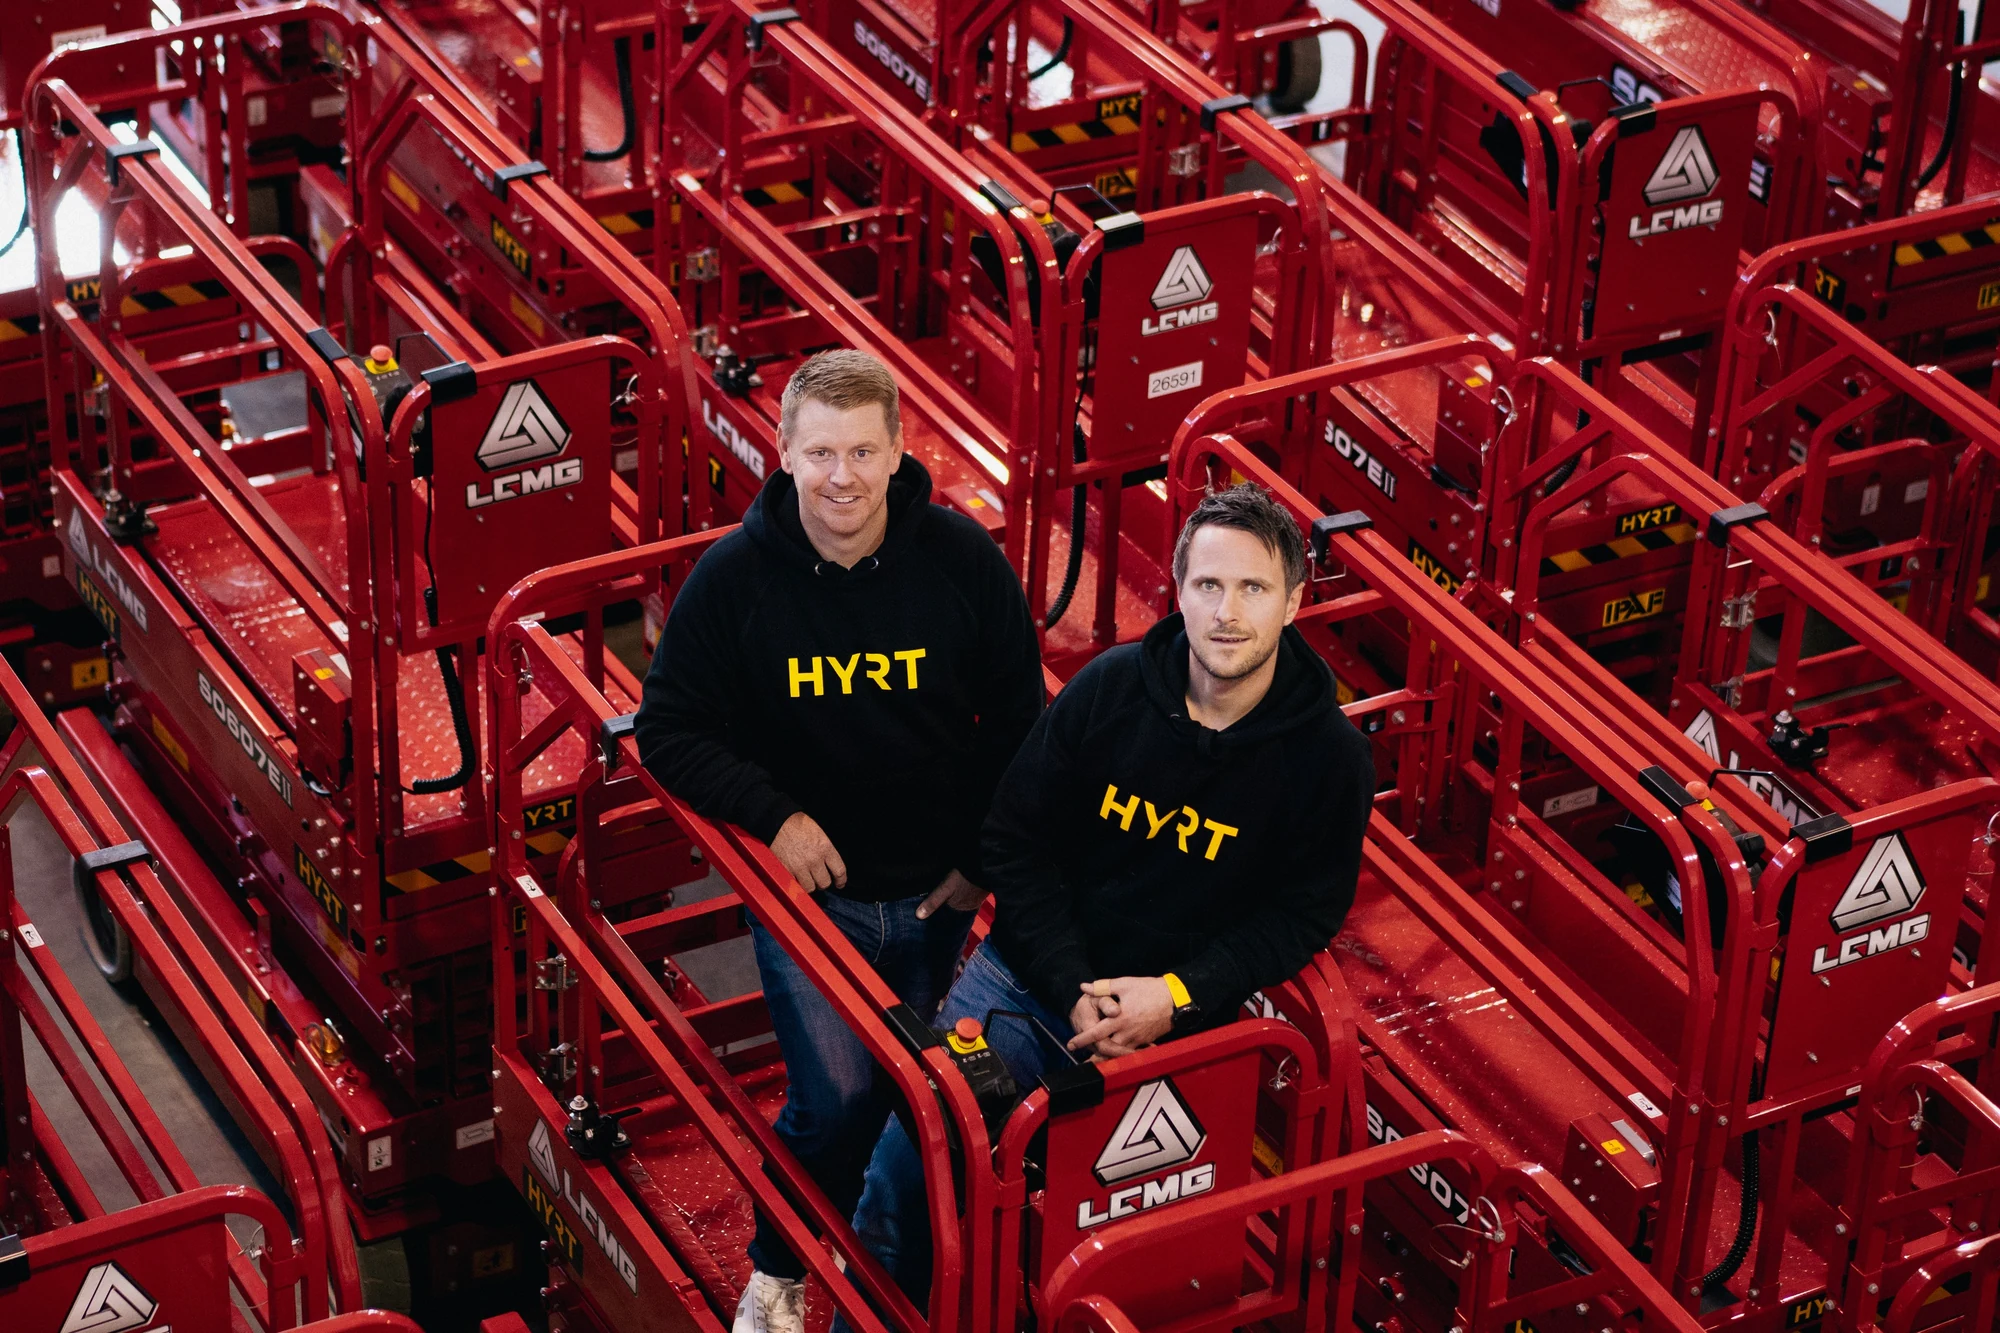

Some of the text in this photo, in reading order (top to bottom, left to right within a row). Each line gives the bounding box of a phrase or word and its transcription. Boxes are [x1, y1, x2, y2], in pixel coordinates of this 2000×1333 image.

[1101, 96, 1138, 117] HYR
[73, 280, 101, 301] HY
[1816, 268, 1838, 300] RT
[1152, 370, 1197, 394] 26591
[1621, 505, 1675, 532] HYRT
[1413, 547, 1459, 592] HYR
[80, 573, 119, 634] HYRT
[788, 648, 926, 697] HYRT
[526, 799, 572, 826] YRT
[1100, 784, 1239, 861] HYRT
[299, 853, 343, 923] HYRT
[529, 1174, 578, 1260] HYRT
[1794, 1297, 1827, 1323] HY
